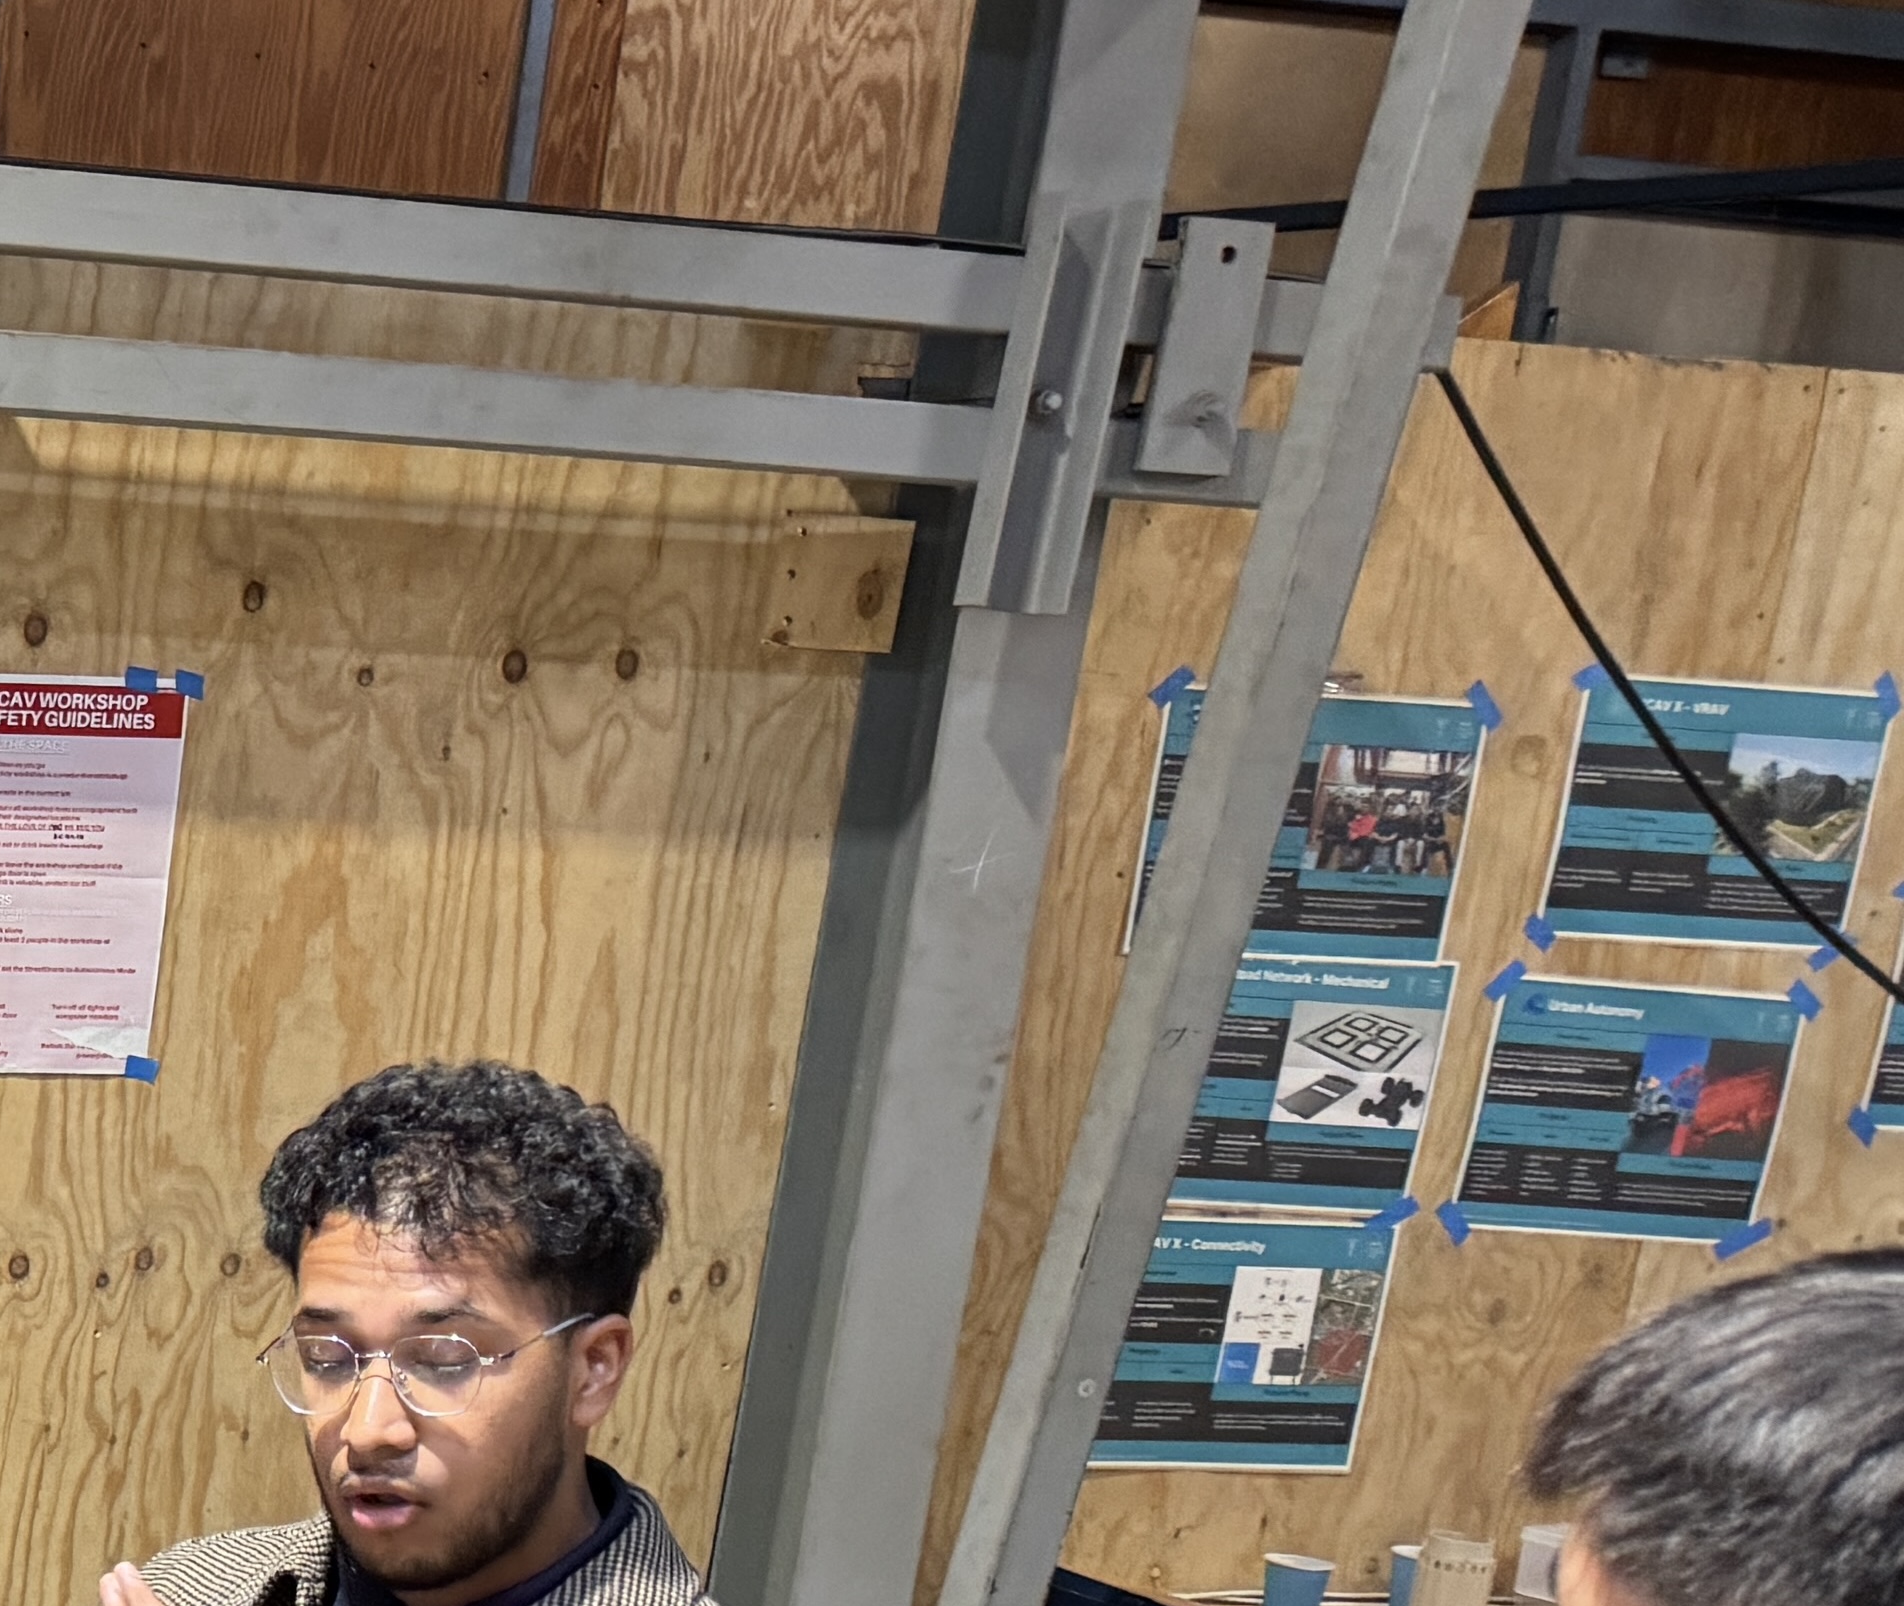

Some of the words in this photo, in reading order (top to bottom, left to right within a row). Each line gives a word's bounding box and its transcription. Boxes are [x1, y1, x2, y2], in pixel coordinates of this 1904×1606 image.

[40, 692, 148, 711] WORKSHOP
[45, 711, 155, 730] GUIDELINES
[1263, 969, 1313, 984] Network
[1322, 973, 1390, 989] Mechanical
[1191, 1238, 1266, 1255] Connectivity
